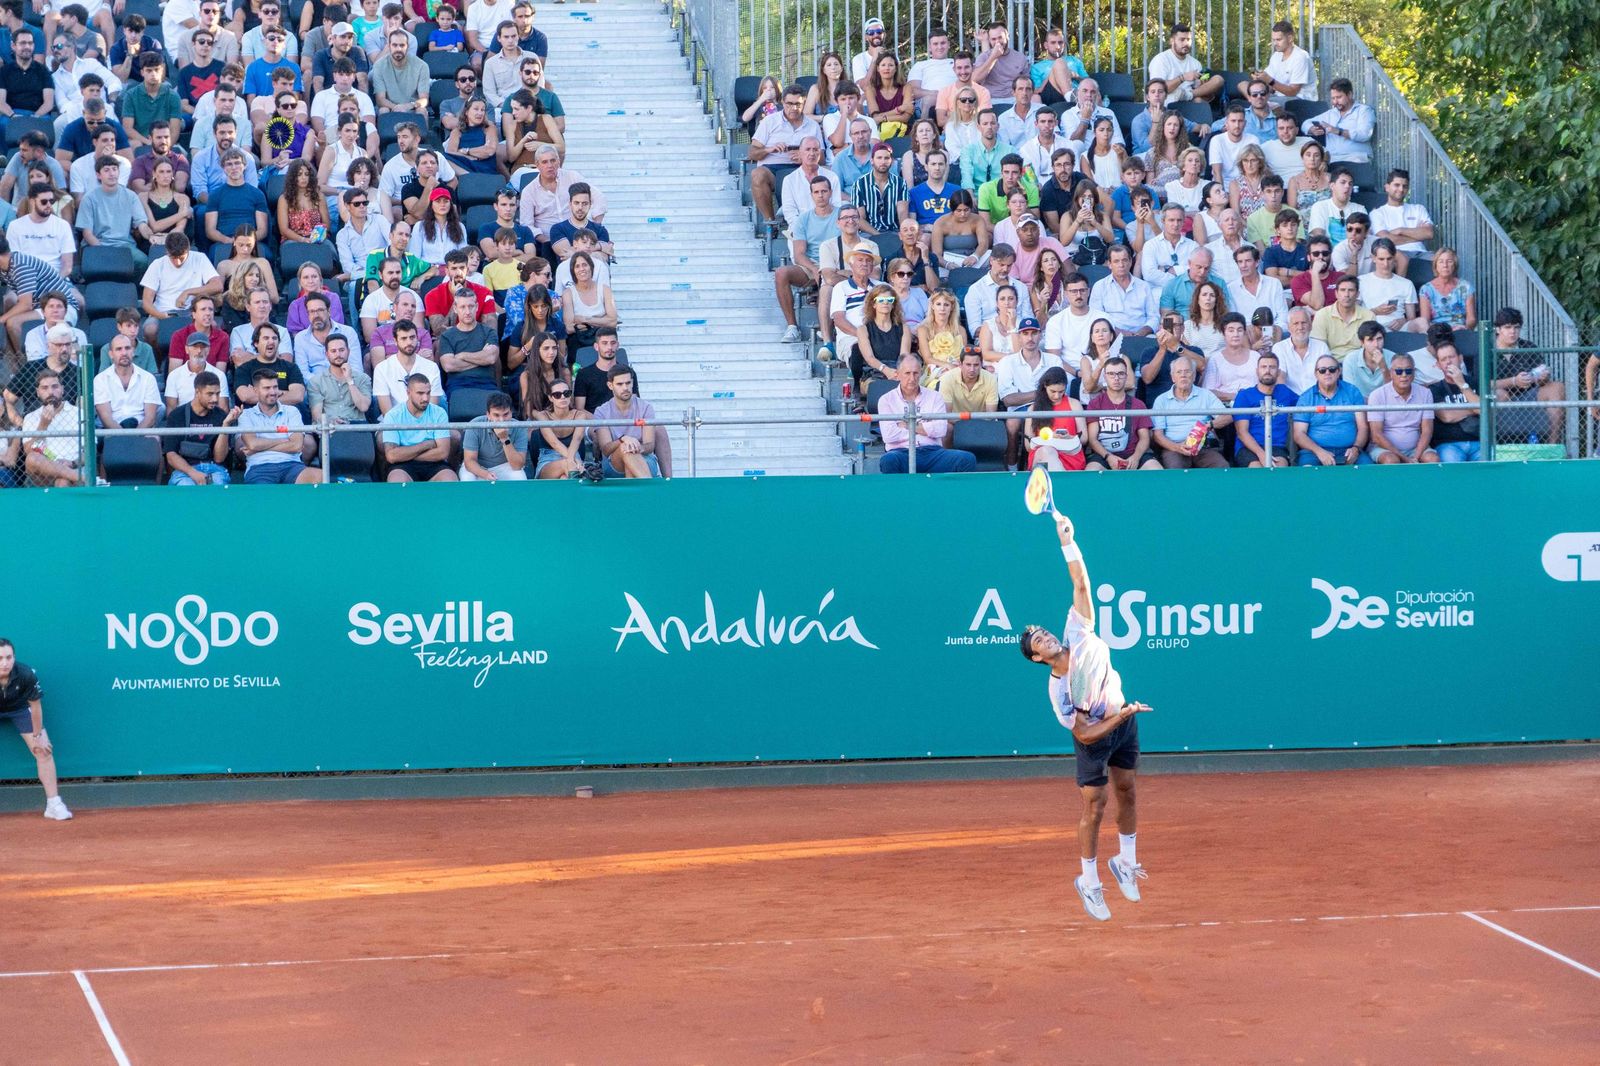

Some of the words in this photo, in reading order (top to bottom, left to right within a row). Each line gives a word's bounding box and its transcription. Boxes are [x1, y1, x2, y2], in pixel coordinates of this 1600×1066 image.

[1395, 588, 1475, 607] Diputación
[347, 600, 515, 646] Sevilla
[611, 588, 880, 654] Andalucía
[1395, 605, 1474, 628] Sevilla
[944, 635, 974, 645] Junta
[975, 634, 989, 645] de
[990, 633, 1020, 645] Andal
[1146, 637, 1190, 649] GRUPO
[111, 677, 210, 690] AYUNTAMIENTO
[213, 677, 230, 688] DE
[233, 674, 281, 688] SEVILLA
